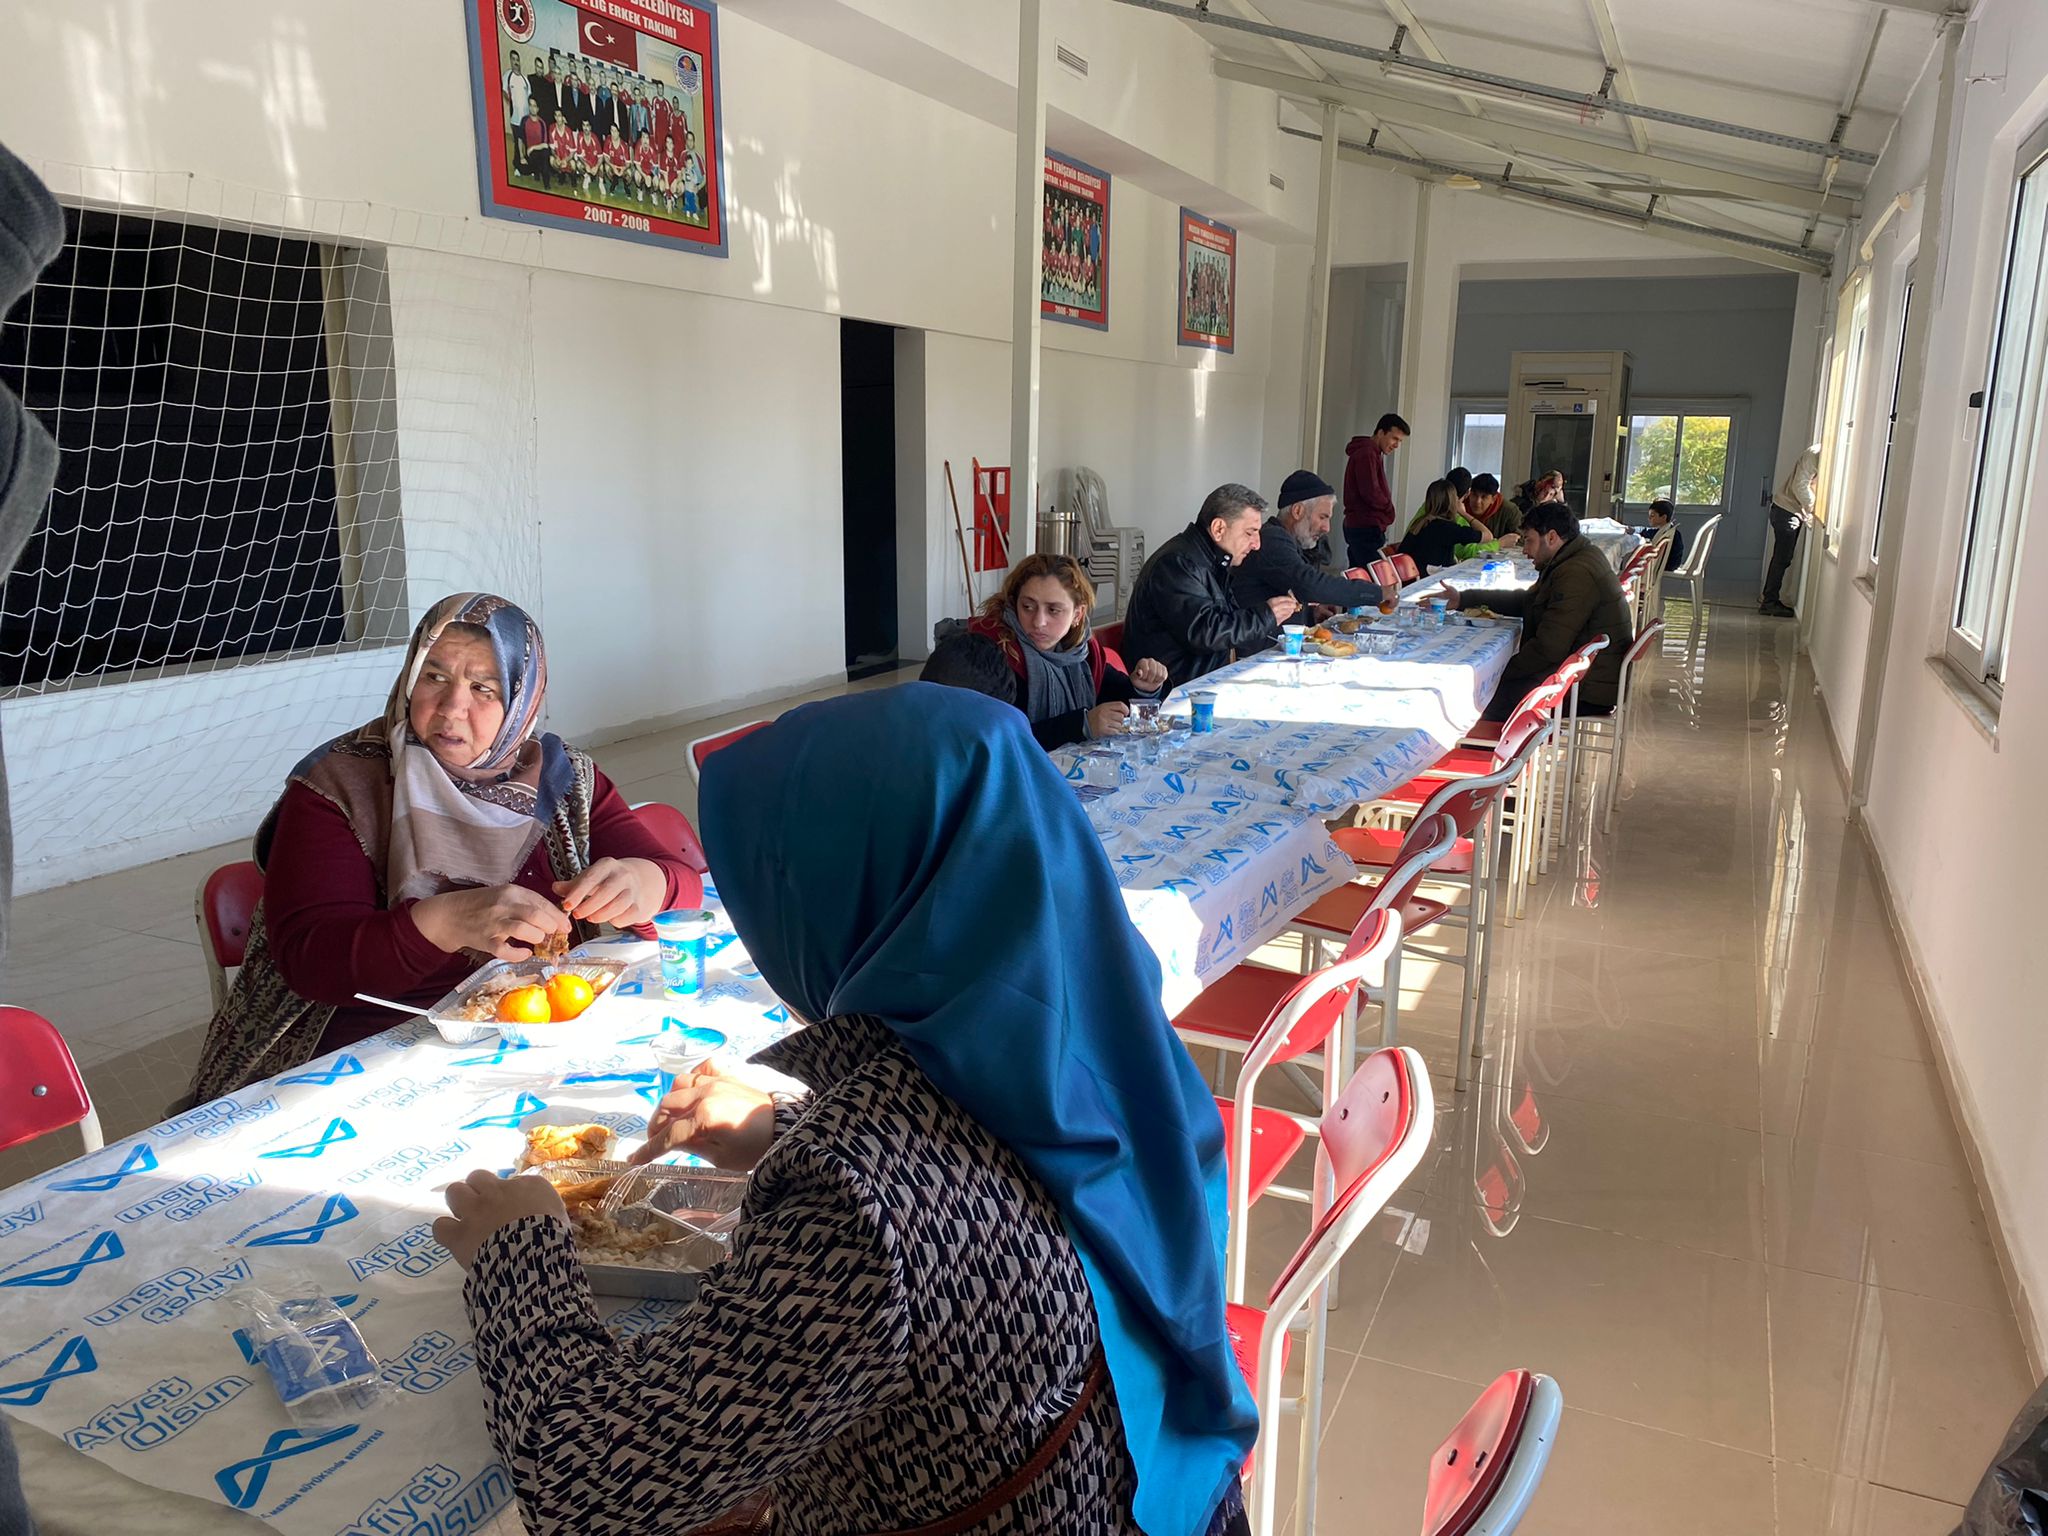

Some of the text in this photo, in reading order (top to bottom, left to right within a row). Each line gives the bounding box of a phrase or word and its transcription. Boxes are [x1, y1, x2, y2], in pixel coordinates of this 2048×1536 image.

[608, 2, 641, 26] ERKEK
[642, 15, 677, 40] TAKIMI
[583, 205, 613, 225] 2007
[621, 213, 650, 232] 2008
[155, 1099, 236, 1136] Olsun
[119, 1177, 213, 1220] Olsun
[168, 1172, 256, 1220] Afiyet
[355, 1227, 433, 1274] Afiyet
[402, 1246, 450, 1274] Ols
[94, 1271, 196, 1323] Olsun
[150, 1264, 244, 1319] Afiyet
[380, 1336, 448, 1382] fiyet
[409, 1351, 475, 1390] Ols
[73, 1383, 183, 1448] Afiyet
[130, 1379, 242, 1446] Olsun
[346, 1471, 452, 1536] fiyet
